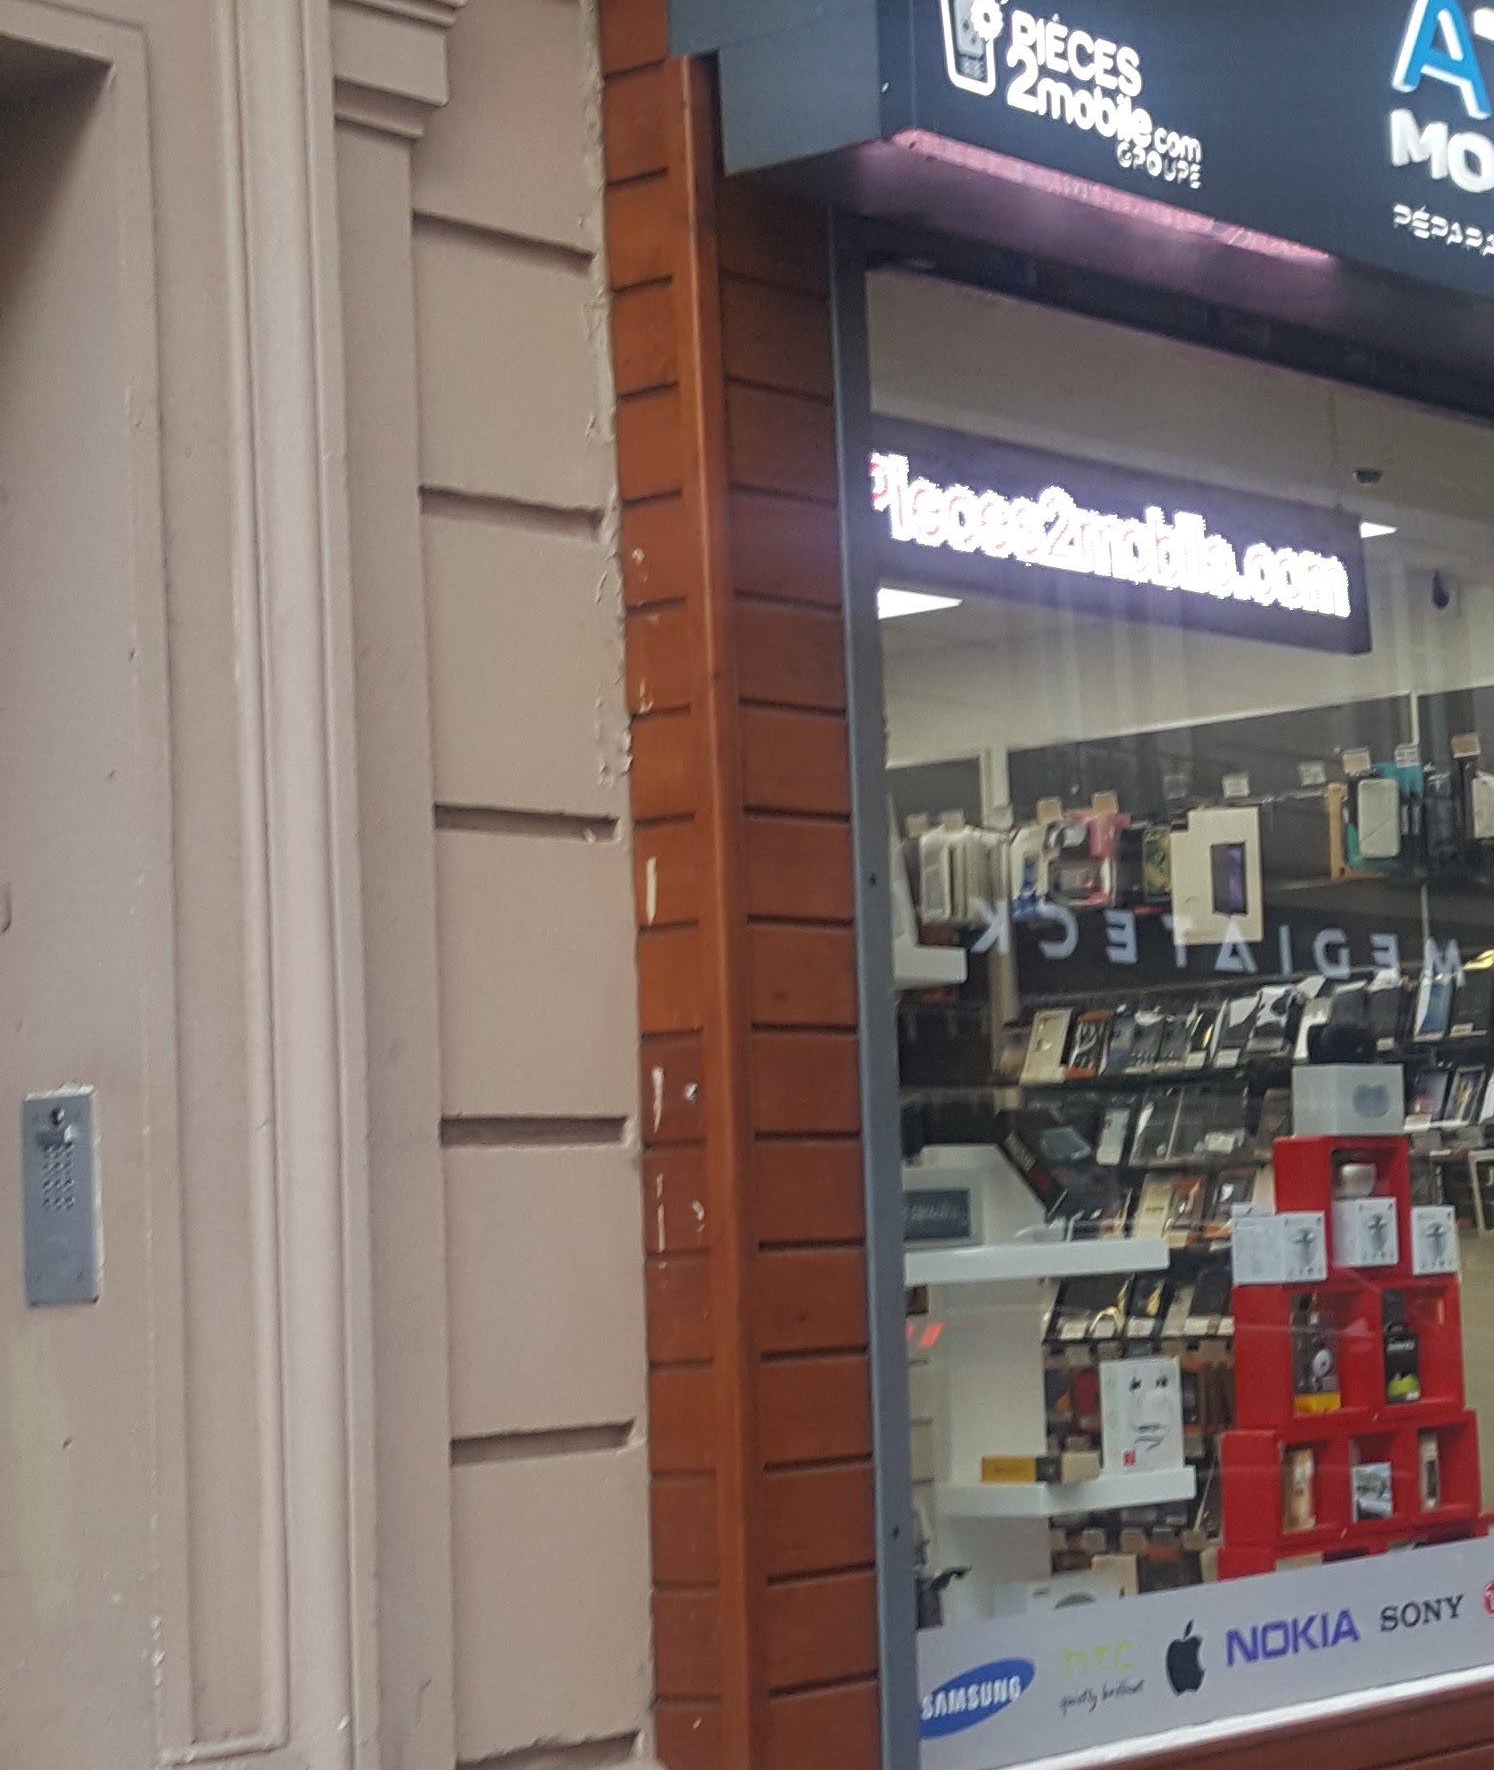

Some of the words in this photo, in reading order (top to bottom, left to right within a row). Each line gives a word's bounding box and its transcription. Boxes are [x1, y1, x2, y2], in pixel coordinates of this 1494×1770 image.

[920, 1675, 1022, 1721] SAMSUNG
[1225, 1608, 1360, 1667] NOKIA
[1379, 1593, 1465, 1633] SONY
